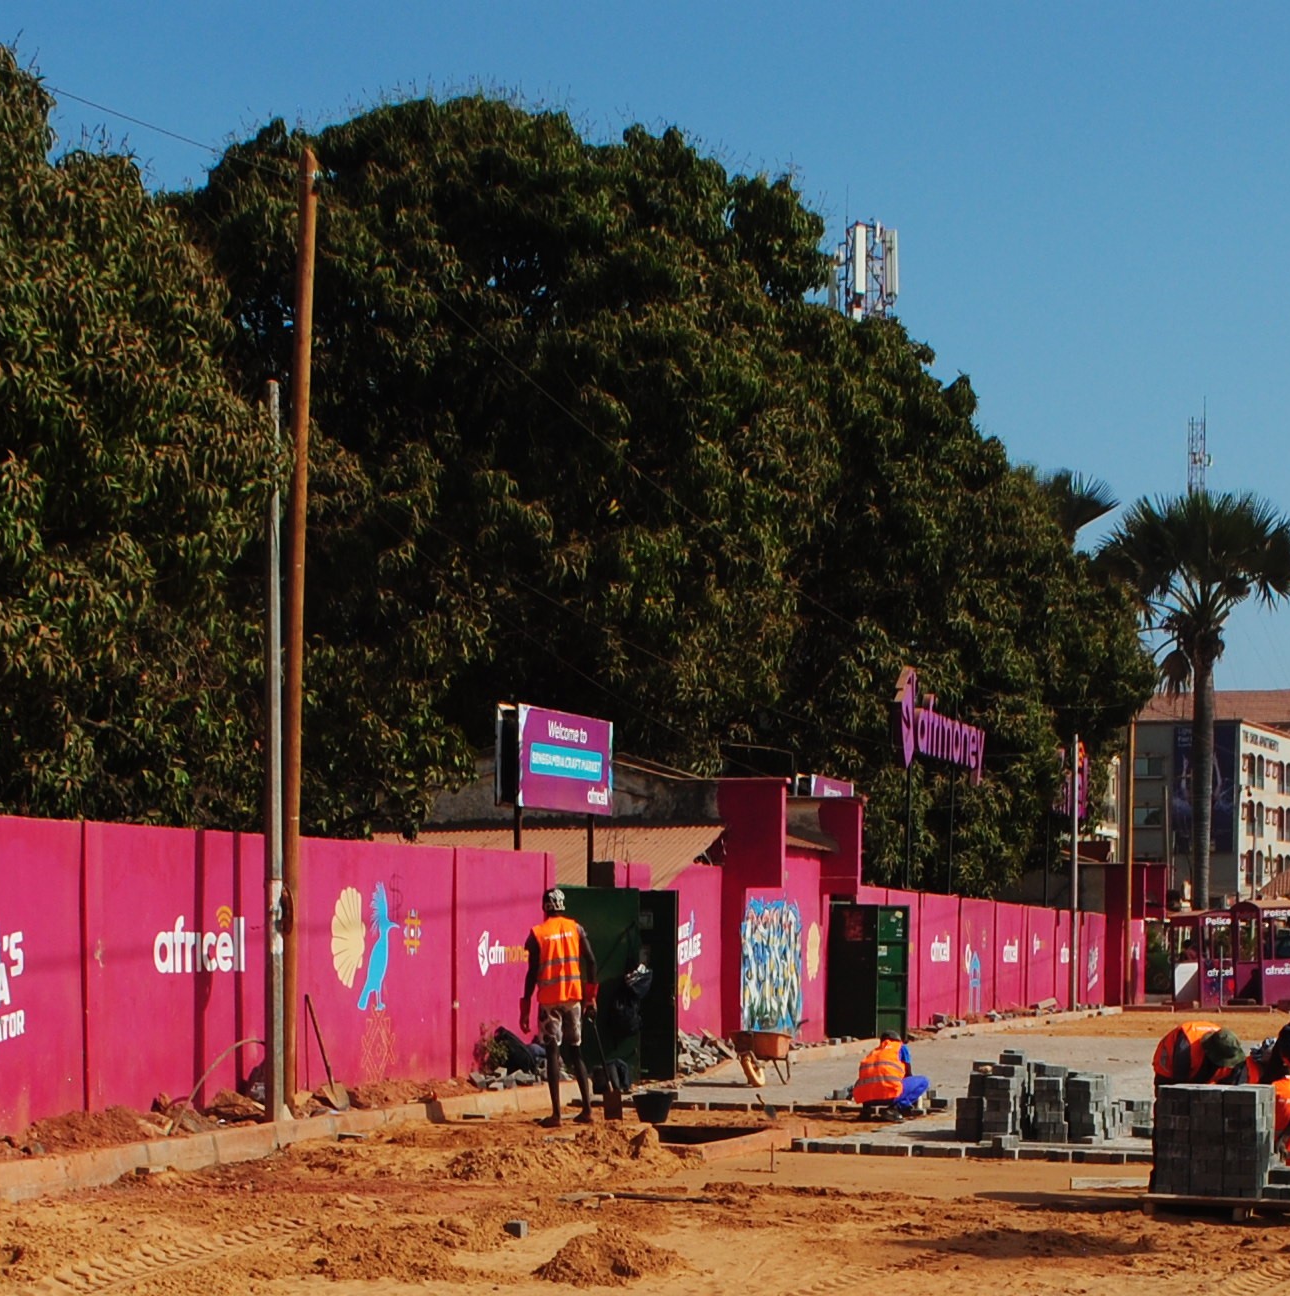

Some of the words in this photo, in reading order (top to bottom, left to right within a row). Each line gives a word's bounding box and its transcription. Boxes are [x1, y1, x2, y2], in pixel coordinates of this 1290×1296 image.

[548, 720, 579, 743] Welcome
[580, 728, 588, 744] to
[1205, 917, 1232, 926] Police
[153, 914, 246, 974] africell
[489, 939, 530, 965] afrimone
[1207, 966, 1234, 977] afrcell
